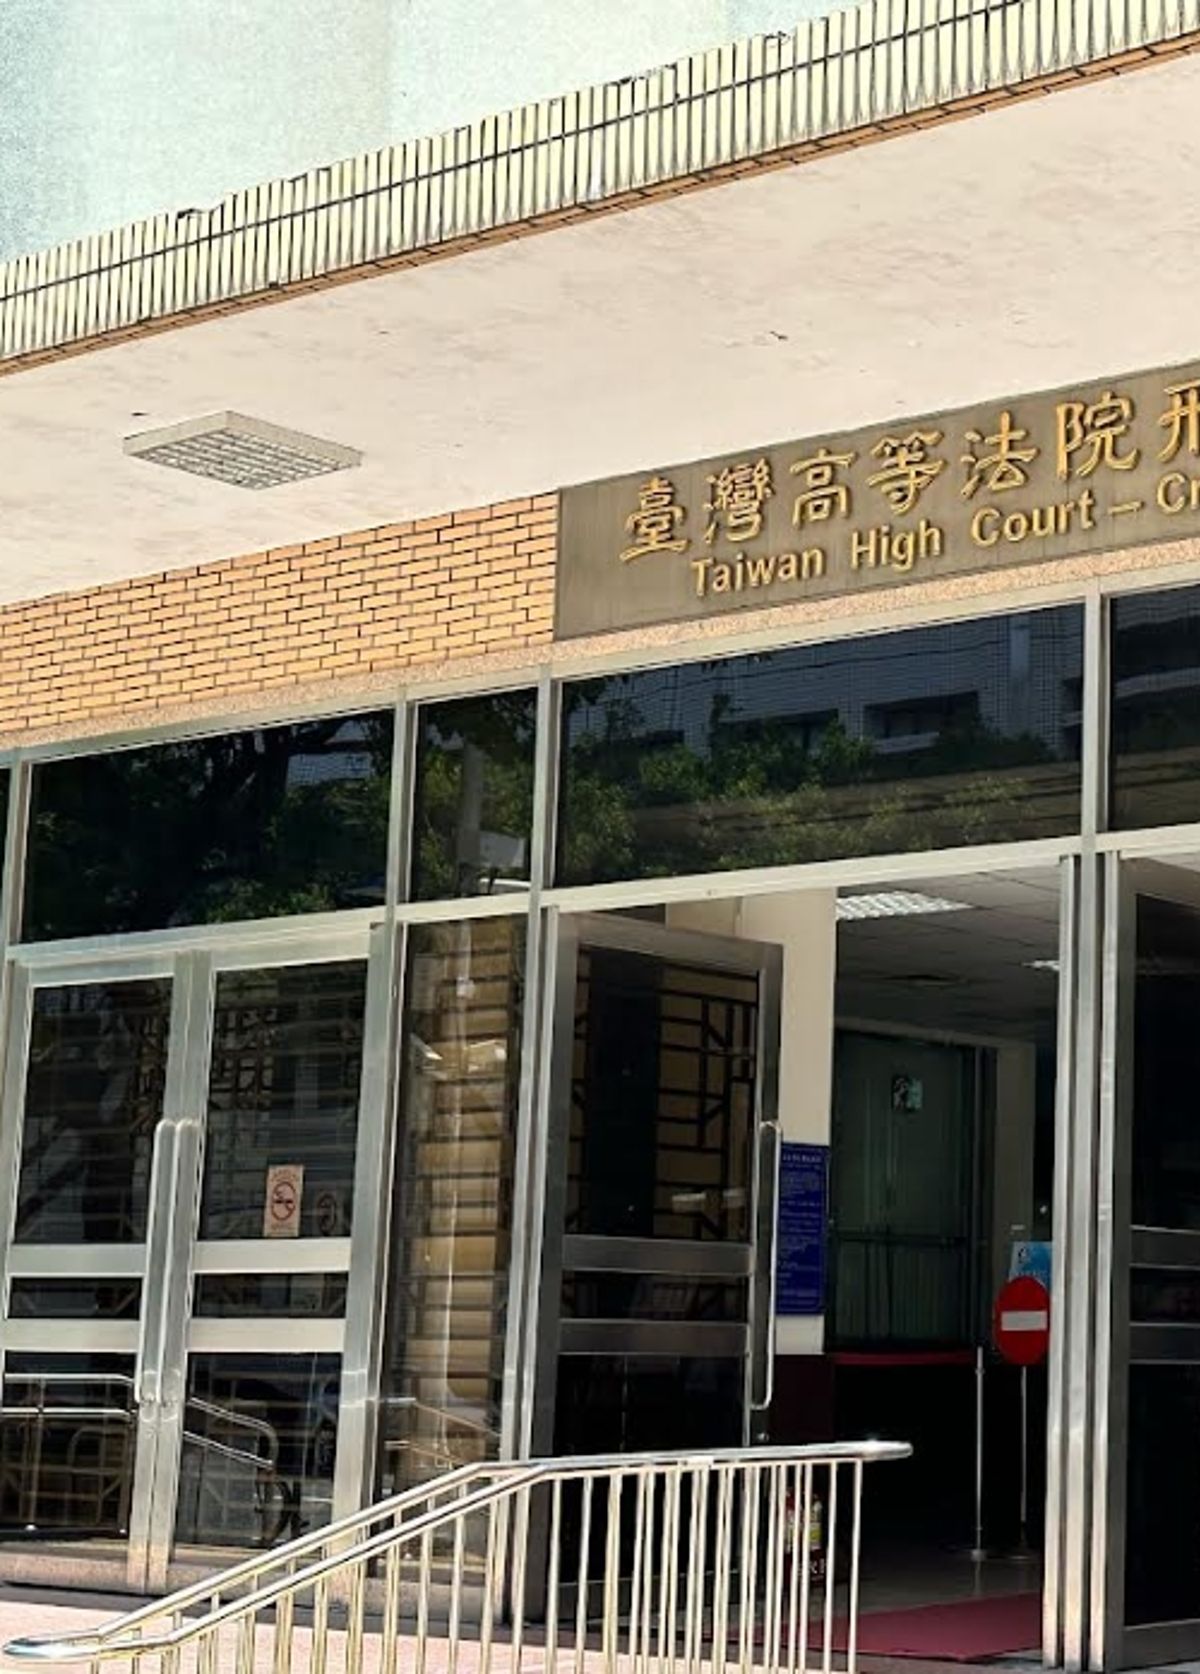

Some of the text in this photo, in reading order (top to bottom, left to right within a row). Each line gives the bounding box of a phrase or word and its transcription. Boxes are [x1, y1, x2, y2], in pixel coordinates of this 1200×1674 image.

[690, 544, 824, 597] Taiwan
[851, 519, 943, 572] High
[971, 490, 1095, 548] Court
